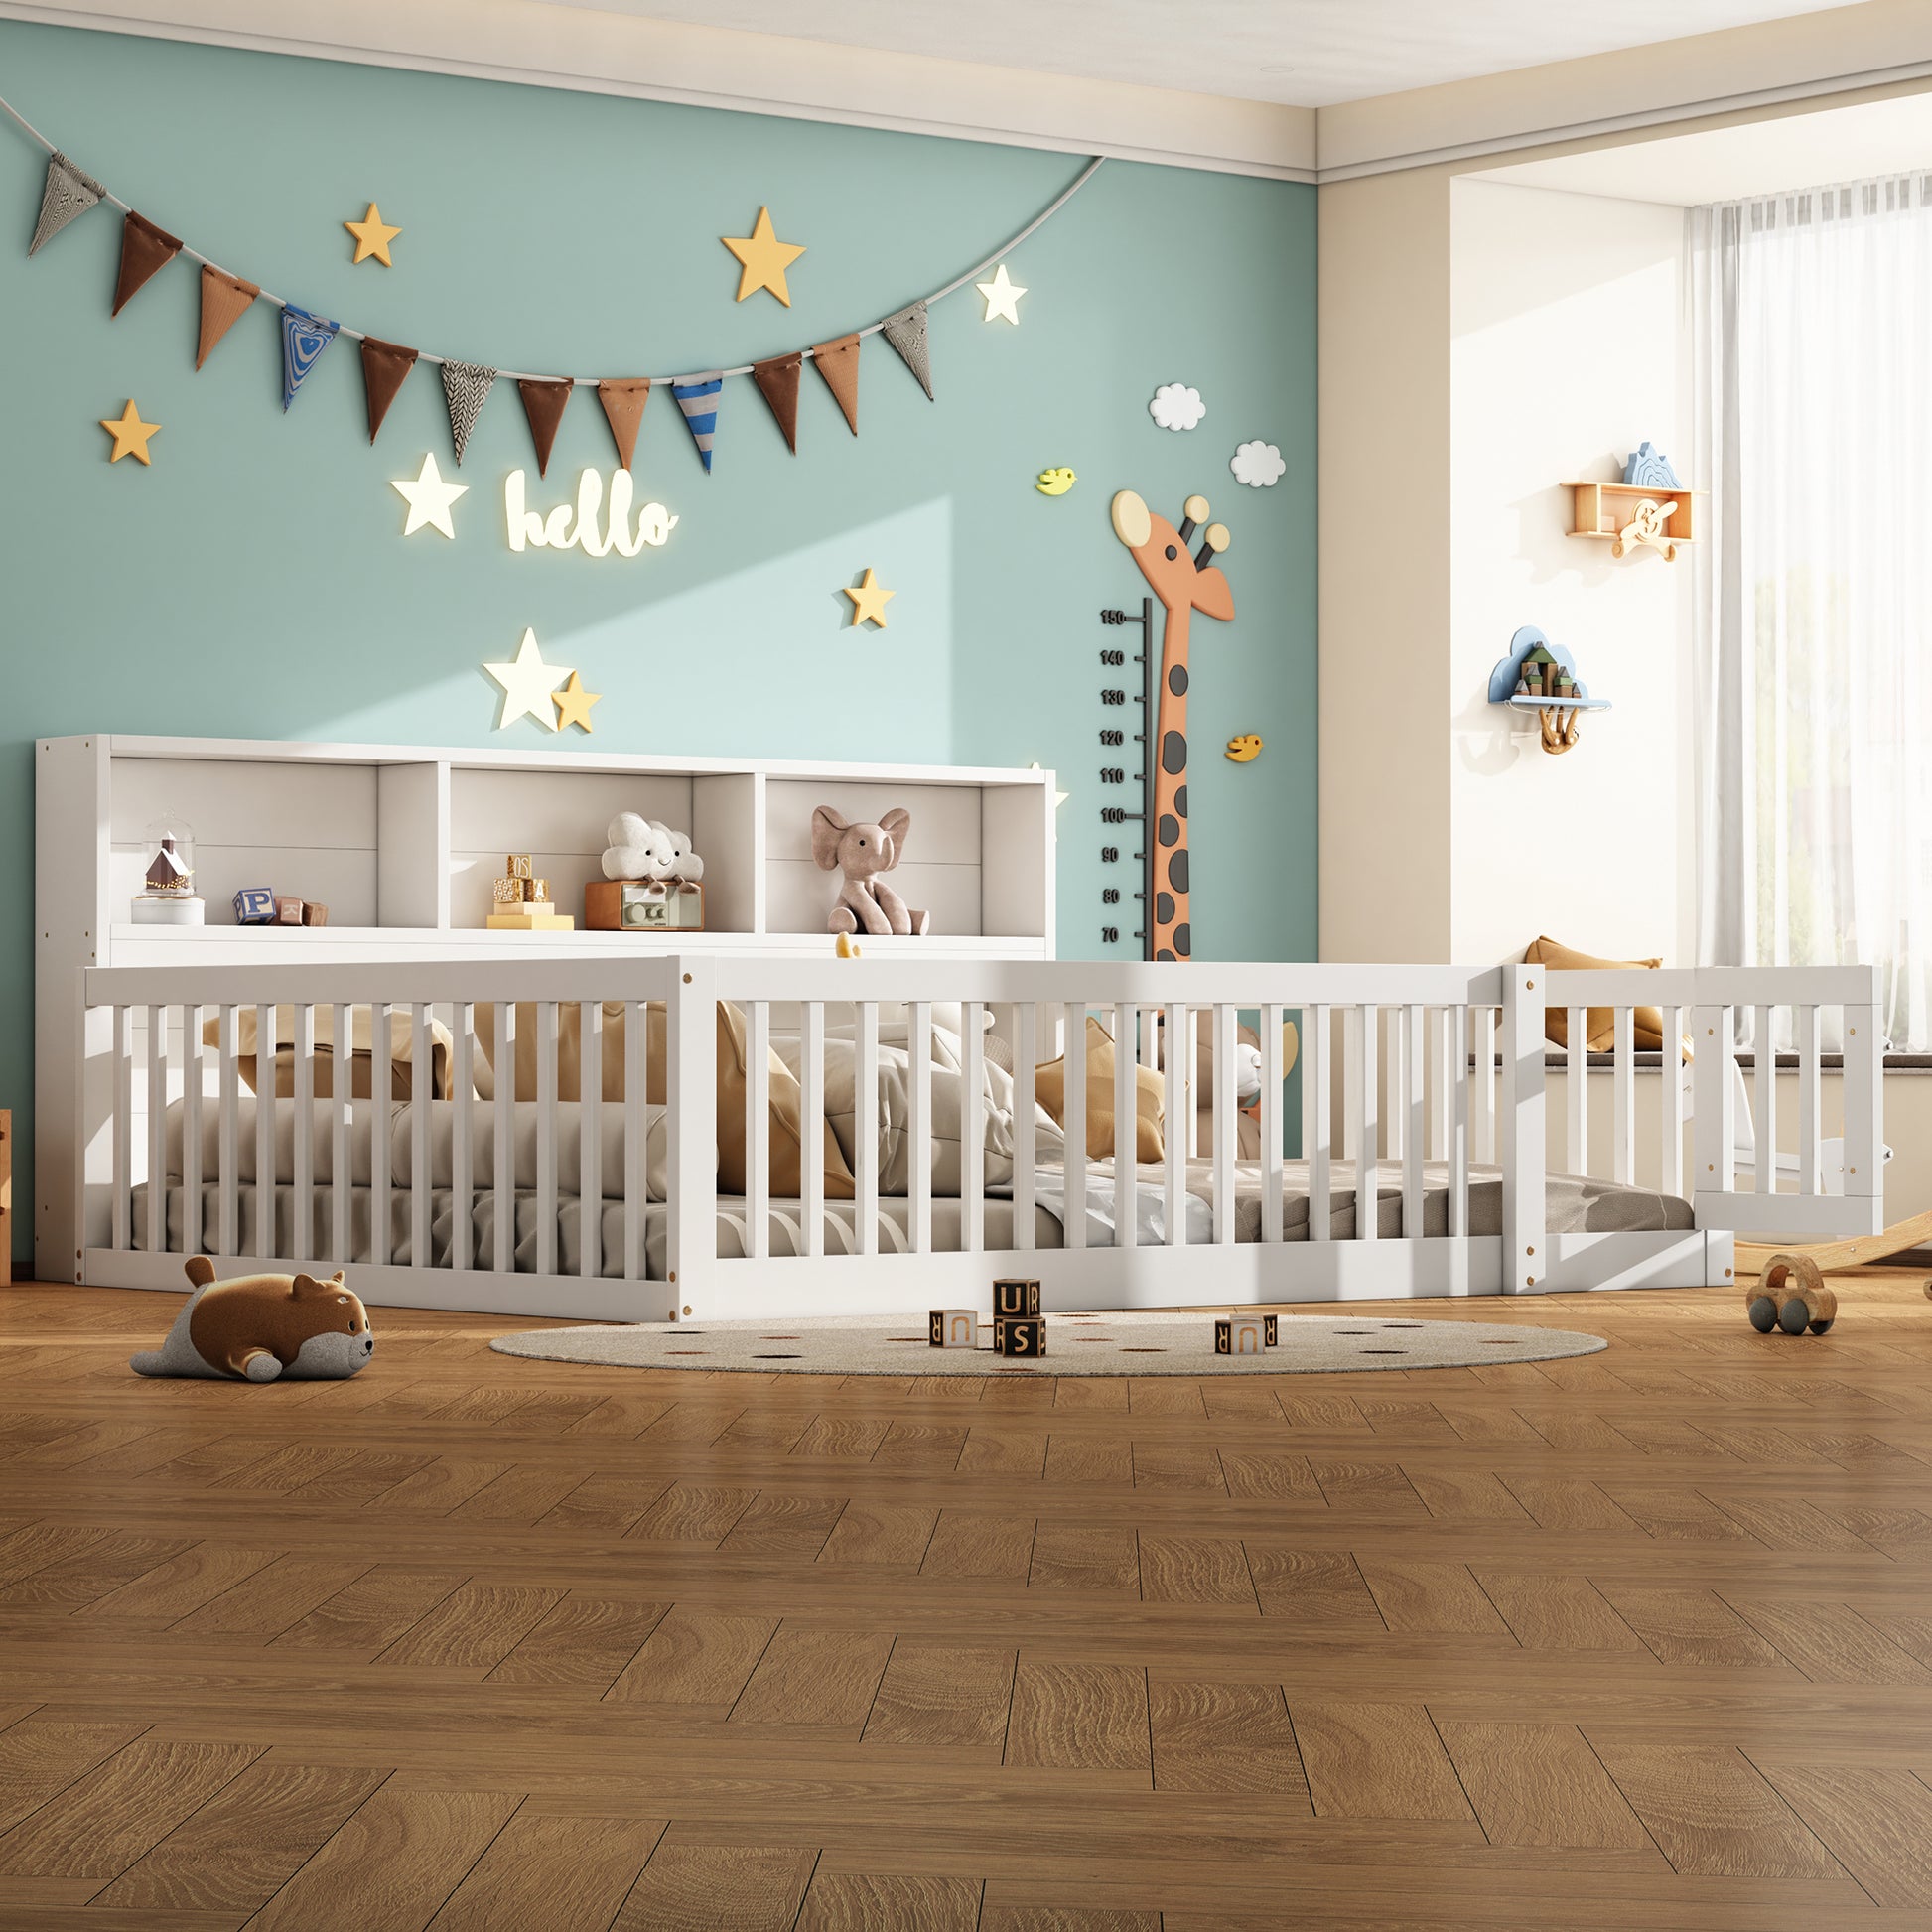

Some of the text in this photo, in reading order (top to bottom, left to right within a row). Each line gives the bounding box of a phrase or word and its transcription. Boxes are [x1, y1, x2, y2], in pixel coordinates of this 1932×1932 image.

[505, 468, 679, 557] hello
[1100, 609, 1125, 625] 150
[1100, 649, 1124, 666] 140
[1101, 689, 1125, 705] 130
[1099, 730, 1124, 746] 120
[1100, 767, 1124, 783] 110
[1101, 807, 1125, 823] 100
[1102, 847, 1119, 862] 90
[536, 882, 545, 897] A
[1103, 889, 1120, 903] 80
[244, 892, 270, 913] P
[1102, 927, 1119, 942] 70
[1000, 1287, 1022, 1313] U
[1031, 1287, 1038, 1312] R
[1014, 1325, 1030, 1352] S
